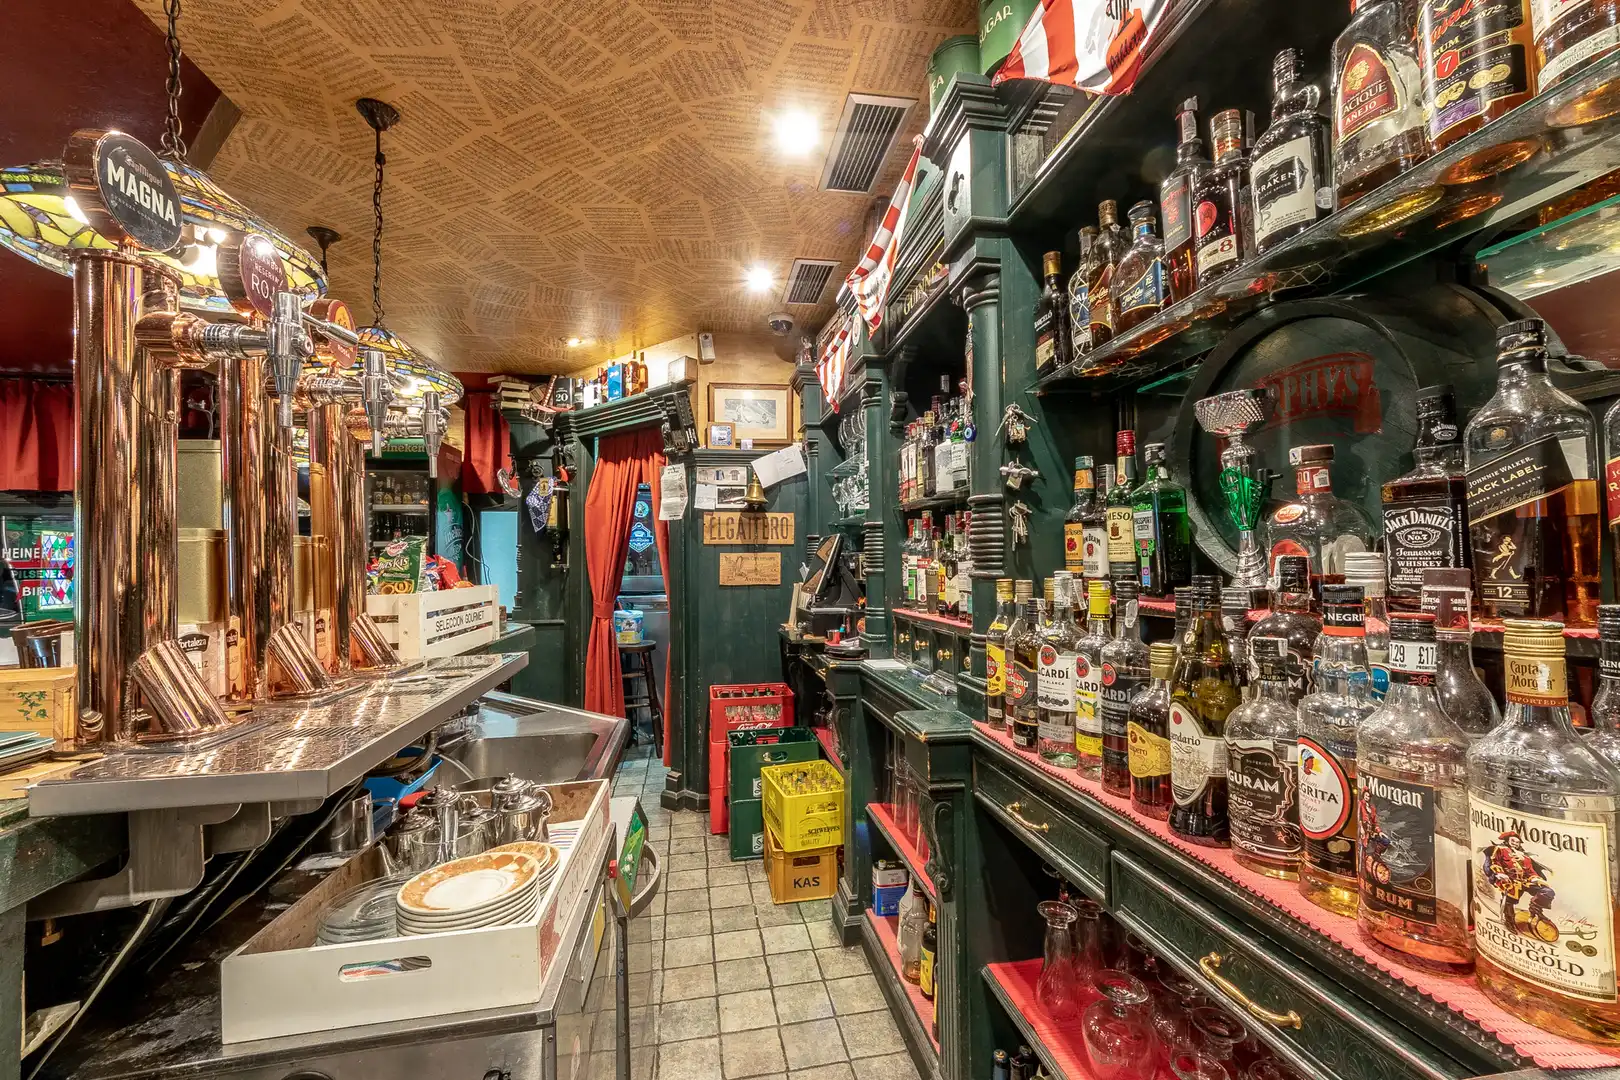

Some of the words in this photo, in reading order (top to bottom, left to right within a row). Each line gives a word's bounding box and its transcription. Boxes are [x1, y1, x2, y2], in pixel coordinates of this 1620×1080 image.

[1433, 36, 1460, 59] RUM
[1442, 56, 1453, 73] 7
[929, 75, 945, 94] EA
[1342, 84, 1388, 118] ACIQUE
[1256, 169, 1297, 194] KRAKEN
[107, 157, 177, 227] MAGNA
[1220, 239, 1233, 253] 8
[556, 393, 568, 402] 20
[382, 443, 425, 453] eineken
[1468, 470, 1500, 489] JOHNNIE
[1465, 480, 1500, 500] BLACK
[1384, 514, 1411, 534] JACK
[1410, 510, 1456, 531] DANIEL'S
[2, 547, 74, 559] HEINEKENS
[1396, 548, 1443, 556] Tennessee
[12, 570, 65, 579] PILSENER
[22, 586, 53, 597] BIER
[1496, 586, 1512, 598] 12
[465, 611, 485, 624] GOURMET
[1040, 668, 1071, 680] CARDÍ
[1510, 661, 1540, 676] Capta
[1101, 687, 1131, 702] CARDÍ
[1508, 694, 1557, 706] IMPORTED
[1171, 731, 1201, 747] endario
[1300, 783, 1339, 805] GRITA
[1369, 775, 1422, 810] Morgan
[807, 826, 840, 835] SCHWEPPES
[1470, 803, 1505, 837] aptain
[1506, 816, 1589, 856] Morgan
[793, 876, 820, 889] KAS
[1376, 886, 1413, 911] RUM
[1485, 920, 1560, 957] ORIGINAL
[1476, 922, 1523, 954] SPICED
[1526, 948, 1585, 977] GOLD
